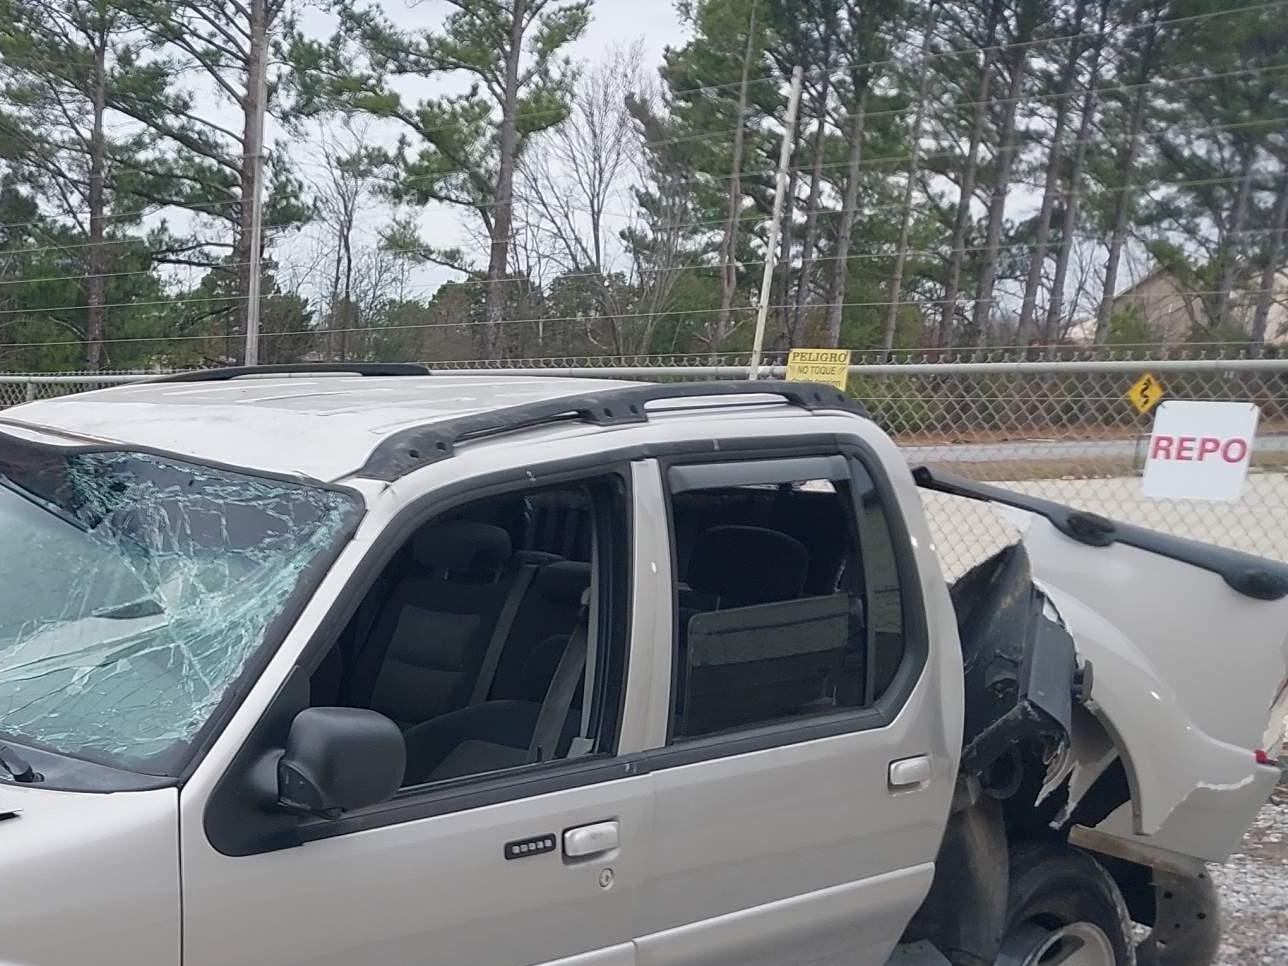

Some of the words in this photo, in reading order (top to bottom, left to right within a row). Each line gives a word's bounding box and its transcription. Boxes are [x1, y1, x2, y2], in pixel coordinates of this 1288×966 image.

[792, 351, 848, 363] PELIGRO
[798, 365, 809, 375] NO
[810, 365, 836, 375] TOQUE
[1151, 435, 1248, 464] REPO
